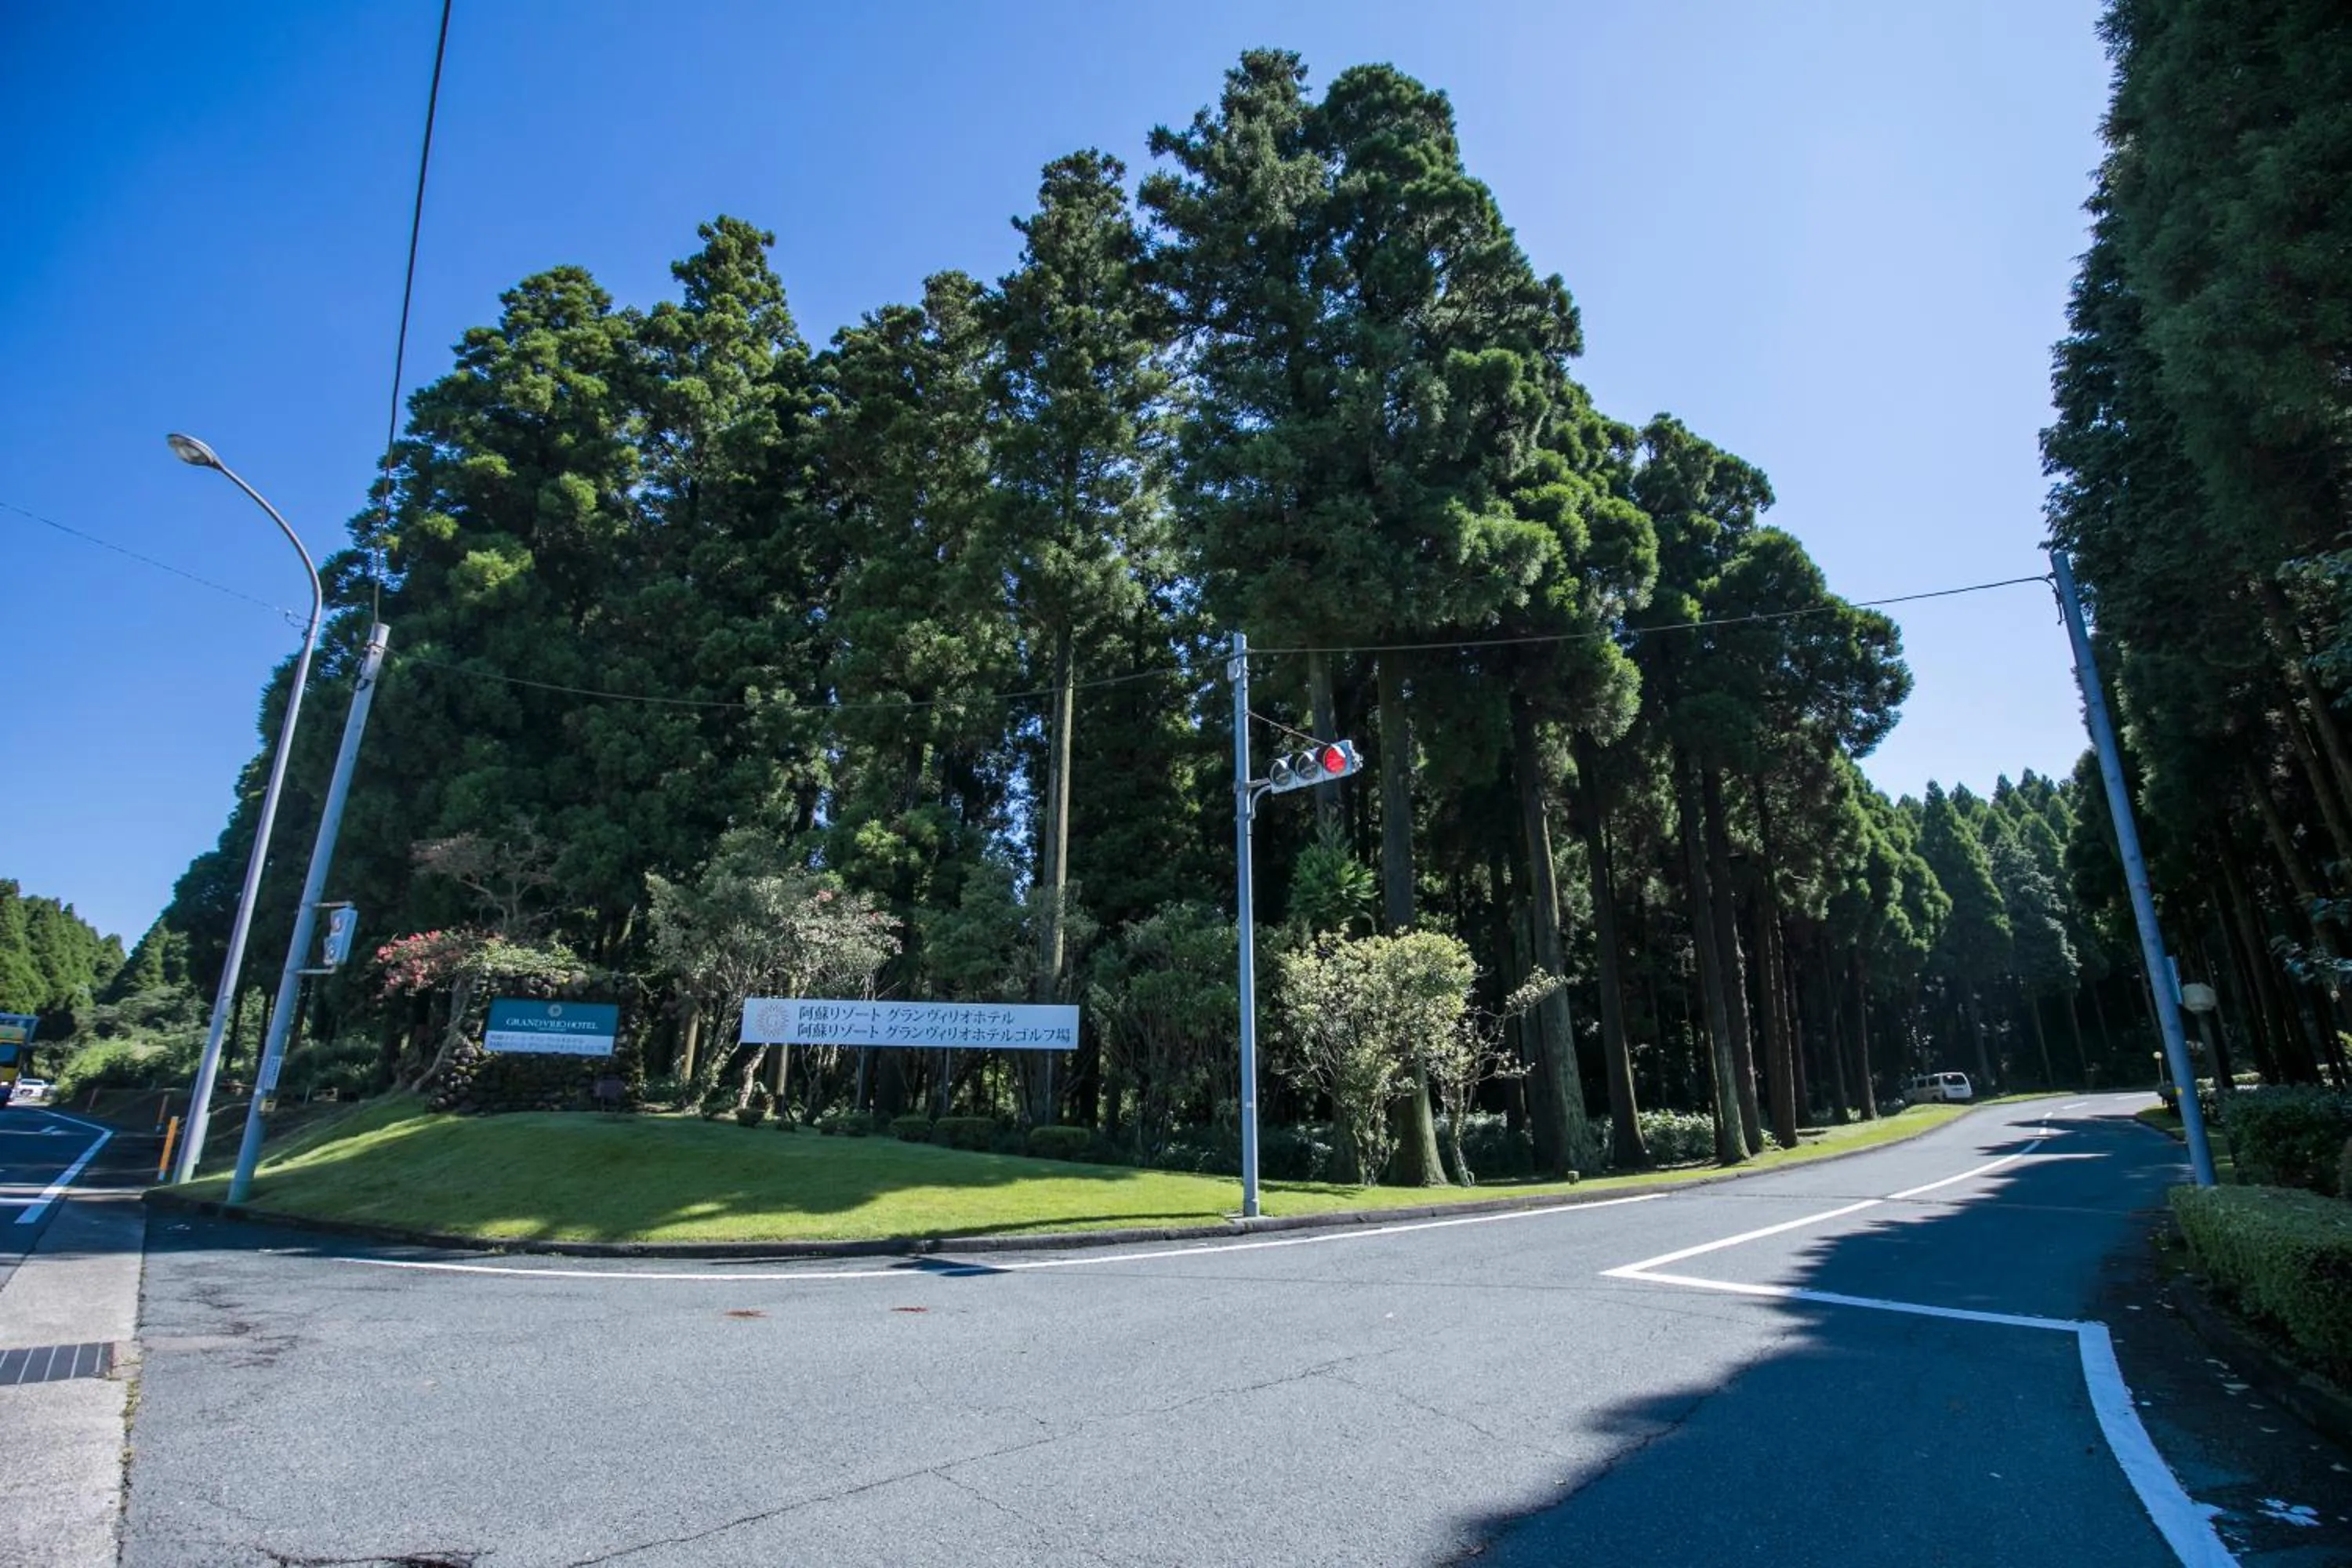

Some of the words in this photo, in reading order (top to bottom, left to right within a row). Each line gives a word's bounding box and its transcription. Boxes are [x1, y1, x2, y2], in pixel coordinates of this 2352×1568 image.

[799, 1006, 880, 1022] 阿蘇リゾート
[889, 1008, 1014, 1025] グランヴィリオホテル
[797, 1022, 879, 1039] 阿蘇リゾート
[886, 1025, 1070, 1044] グランヴィリオホテルゴルフ場
